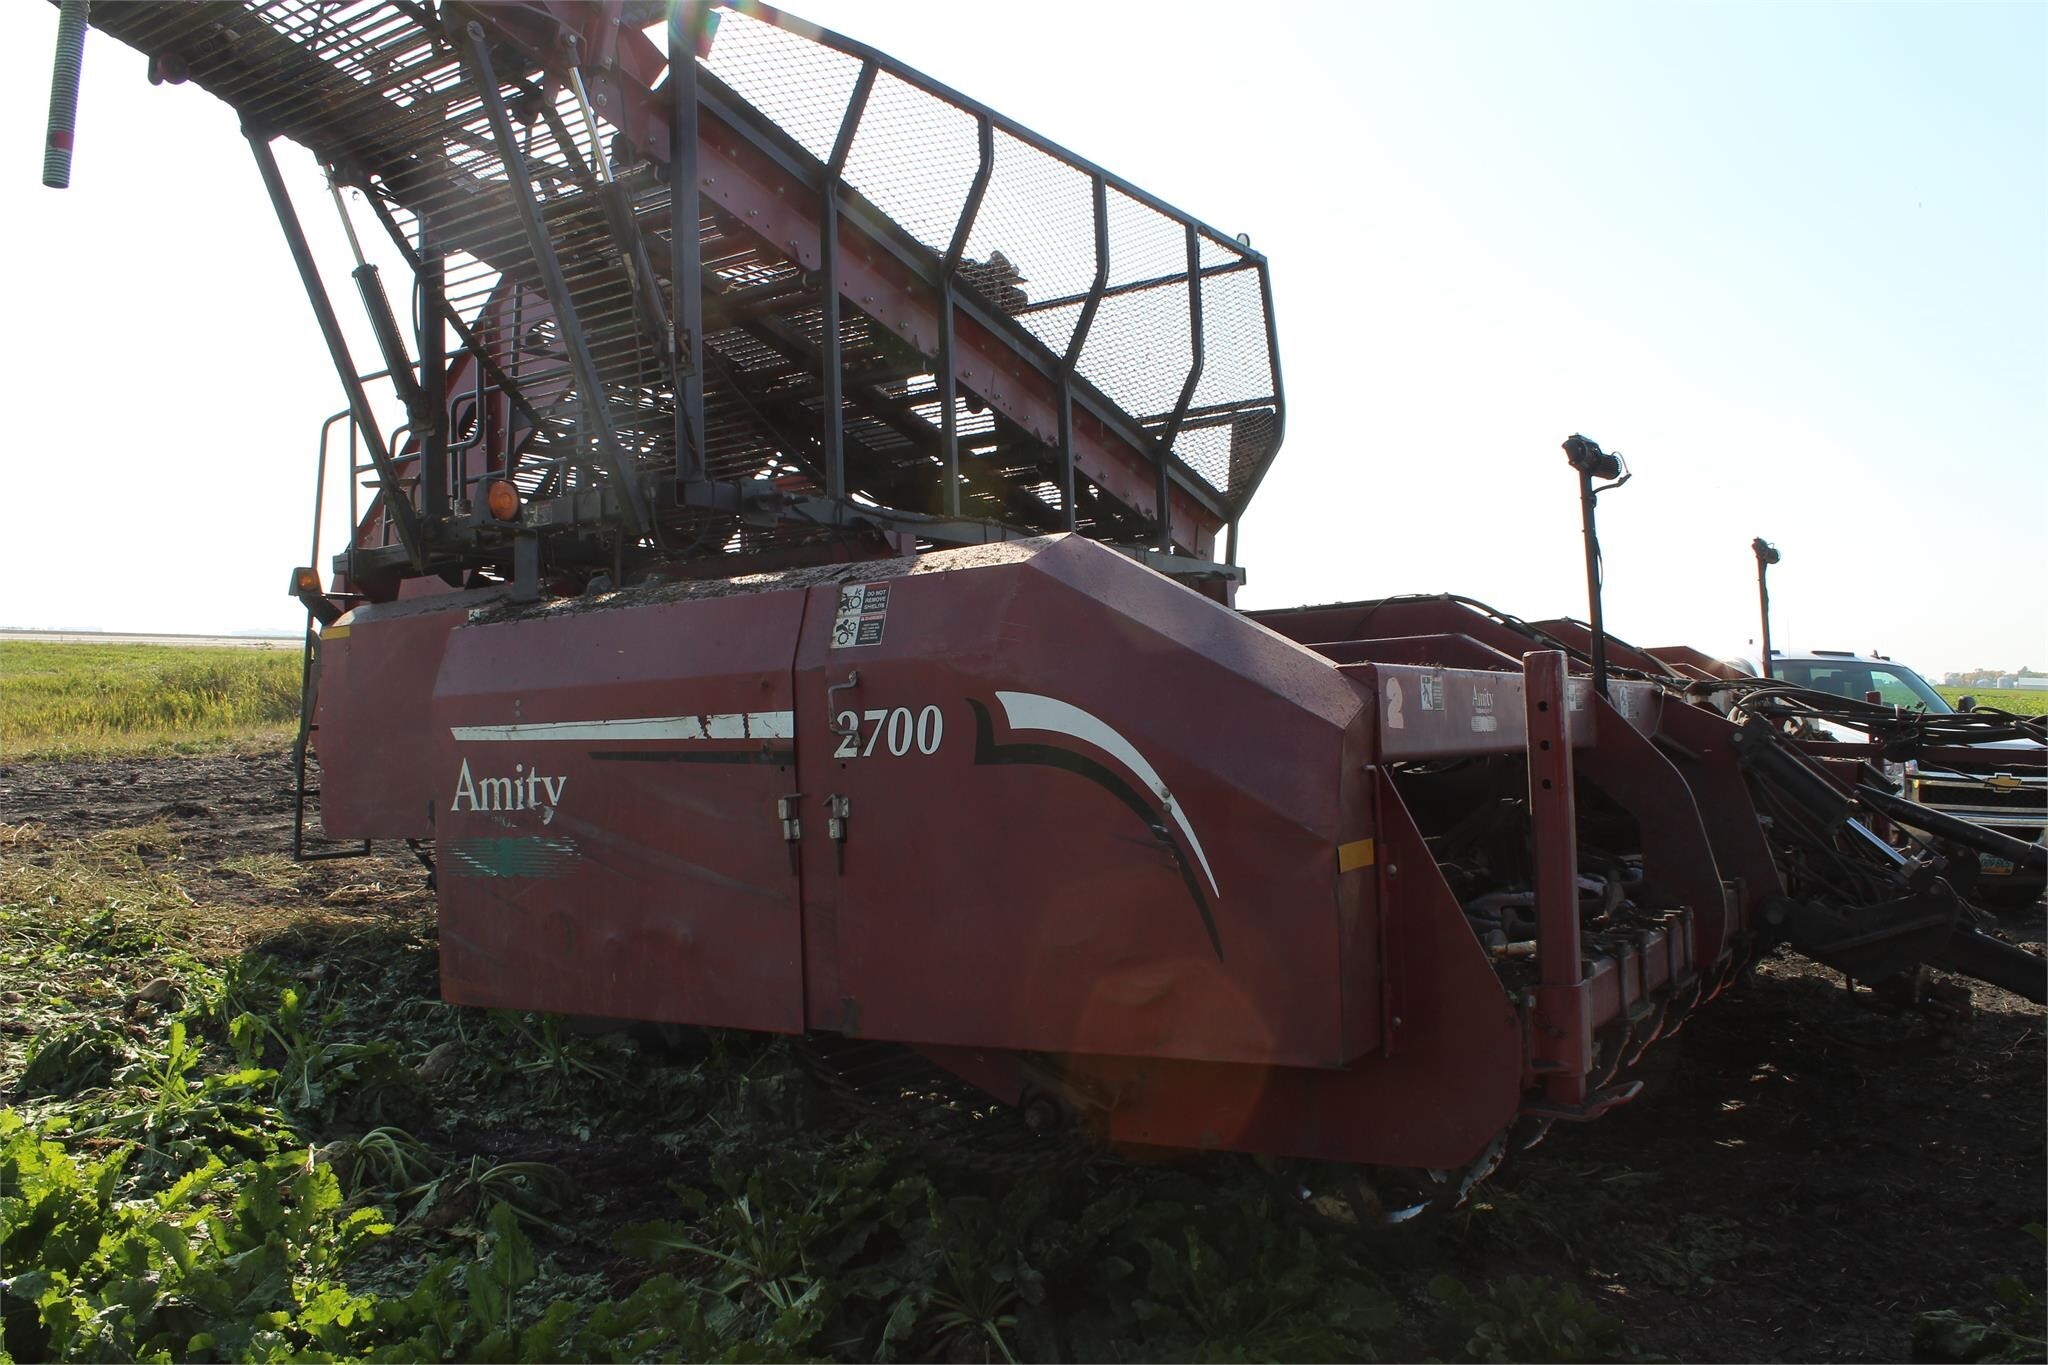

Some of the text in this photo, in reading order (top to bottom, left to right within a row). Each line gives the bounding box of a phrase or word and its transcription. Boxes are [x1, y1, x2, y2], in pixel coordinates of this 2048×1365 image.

[864, 596, 886, 604] REMOVE
[1472, 683, 1494, 708] Amity
[833, 704, 943, 759] 2700
[450, 757, 567, 826] Amity
